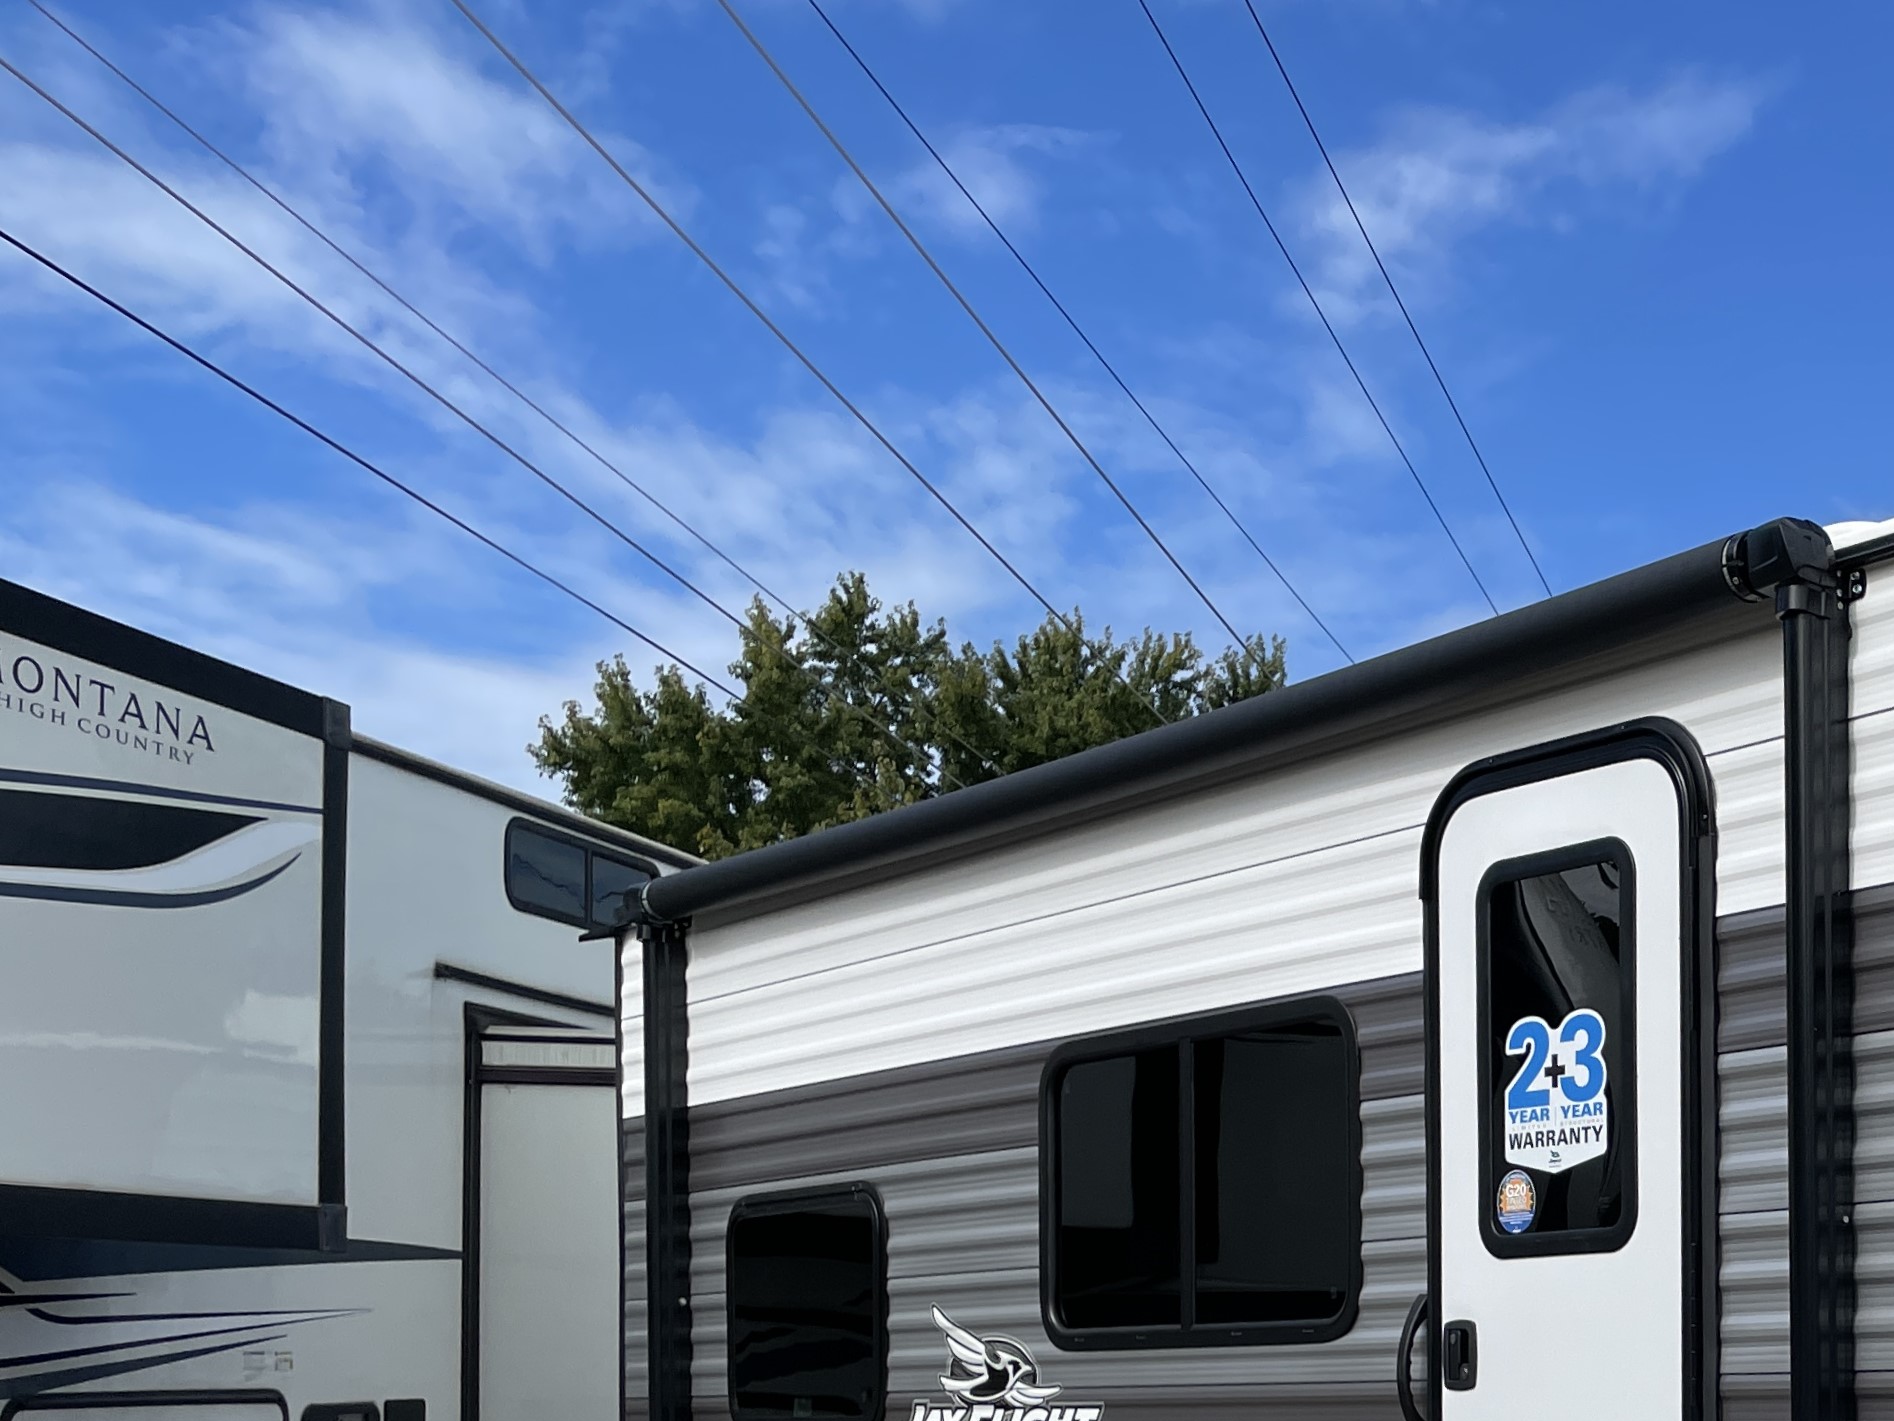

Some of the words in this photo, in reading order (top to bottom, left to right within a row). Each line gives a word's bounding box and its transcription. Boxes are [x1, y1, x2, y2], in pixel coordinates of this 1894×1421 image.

[0, 648, 215, 752] ONTANA
[77, 717, 194, 765] COUNTRY
[1508, 1107, 1550, 1124] YEAR
[1560, 1102, 1604, 1119] YEAR
[1508, 1125, 1604, 1150] WARRANTY
